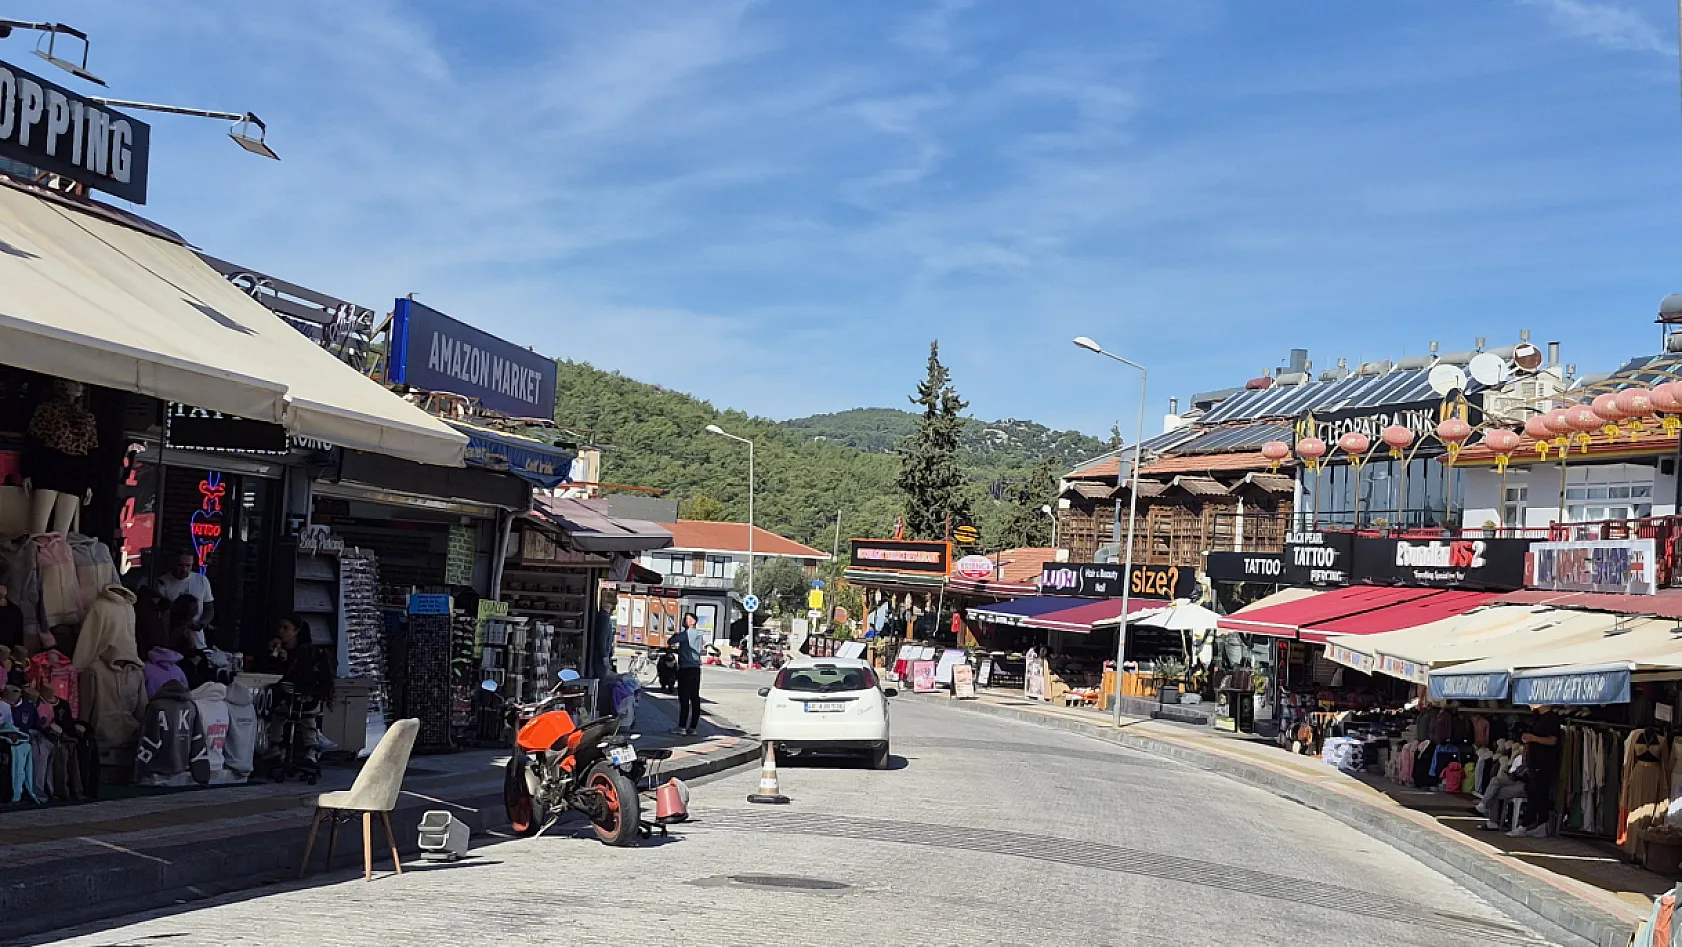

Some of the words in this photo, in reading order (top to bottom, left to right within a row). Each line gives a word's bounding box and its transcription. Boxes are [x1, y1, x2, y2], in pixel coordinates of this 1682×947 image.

[428, 331, 490, 388] AMAZON
[492, 355, 542, 405] MARKET
[1407, 408, 1435, 441] INK
[1243, 558, 1281, 575] TATTOO
[1293, 546, 1334, 567] TATTOO
